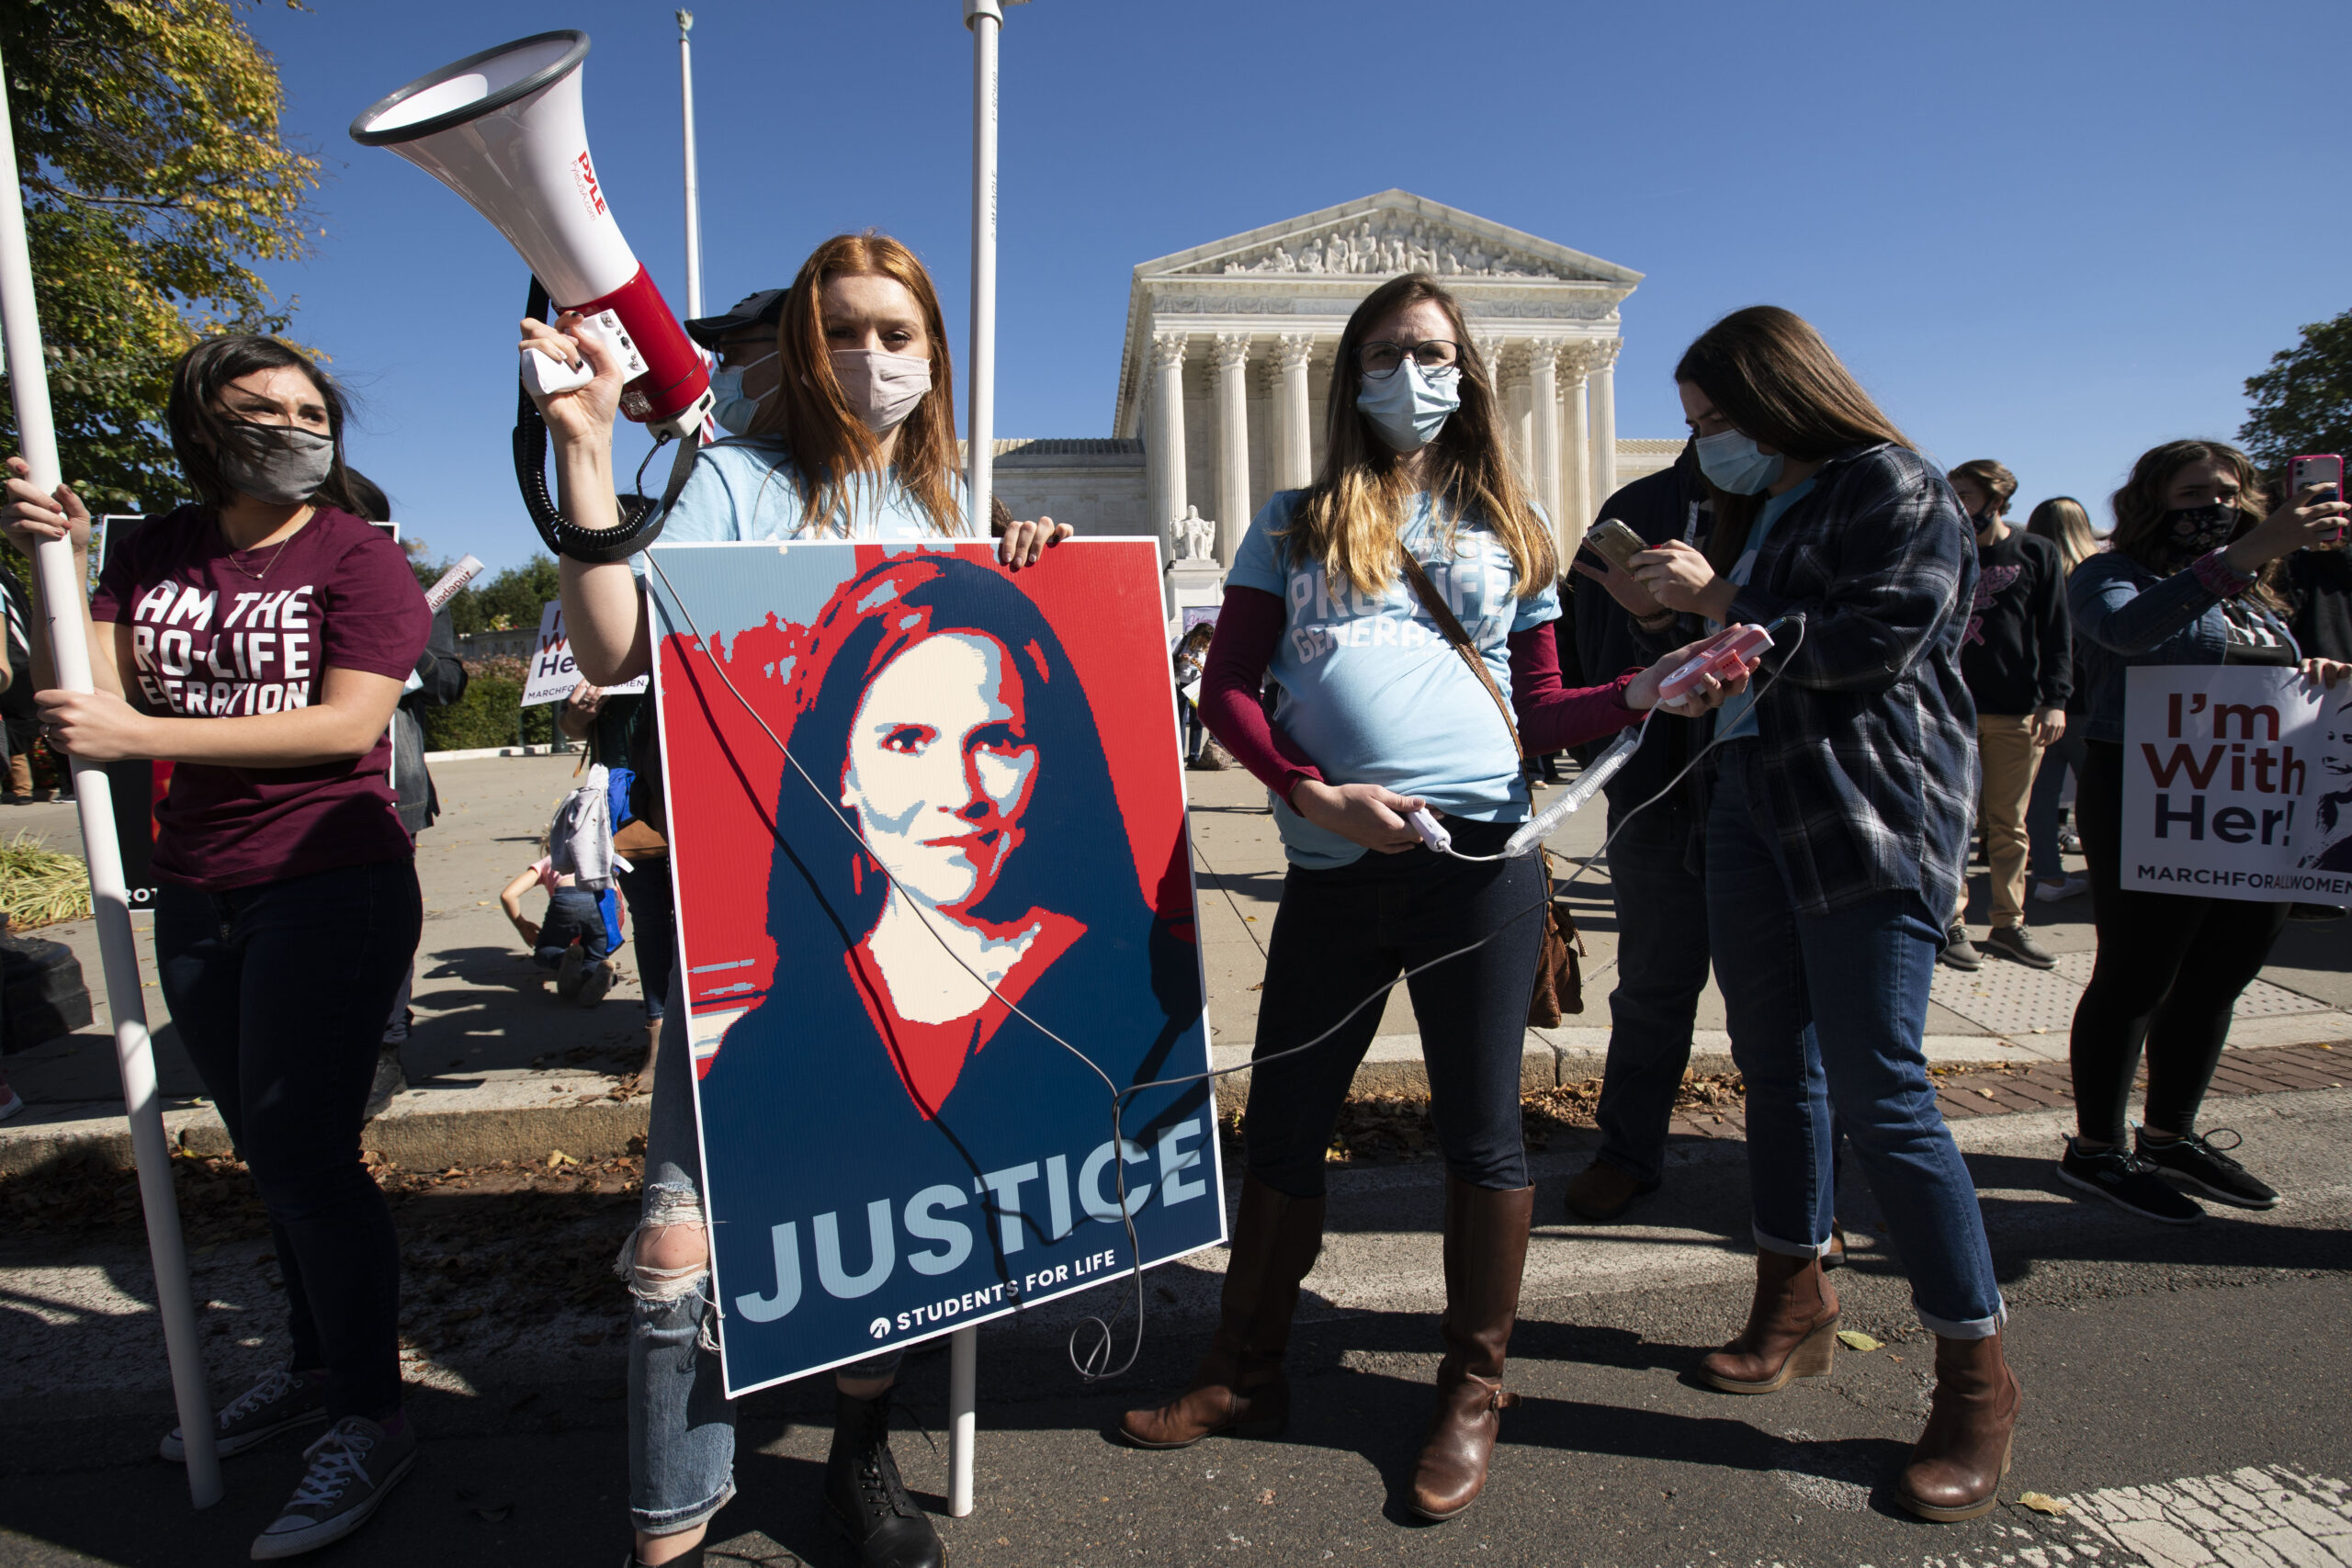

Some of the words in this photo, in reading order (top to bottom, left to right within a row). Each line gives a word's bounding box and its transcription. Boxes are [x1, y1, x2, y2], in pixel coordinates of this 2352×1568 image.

[134, 580, 219, 631] AM
[223, 585, 313, 628] THE
[537, 654, 580, 678] He
[2167, 694, 2279, 741] I'm
[2141, 742, 2306, 795] With
[2154, 793, 2295, 847] Her!
[735, 1117, 1206, 1323] JUSTICE
[897, 1280, 1019, 1331] STUDENTS
[1025, 1264, 1069, 1292] FOR
[1075, 1249, 1116, 1277] LIFE
